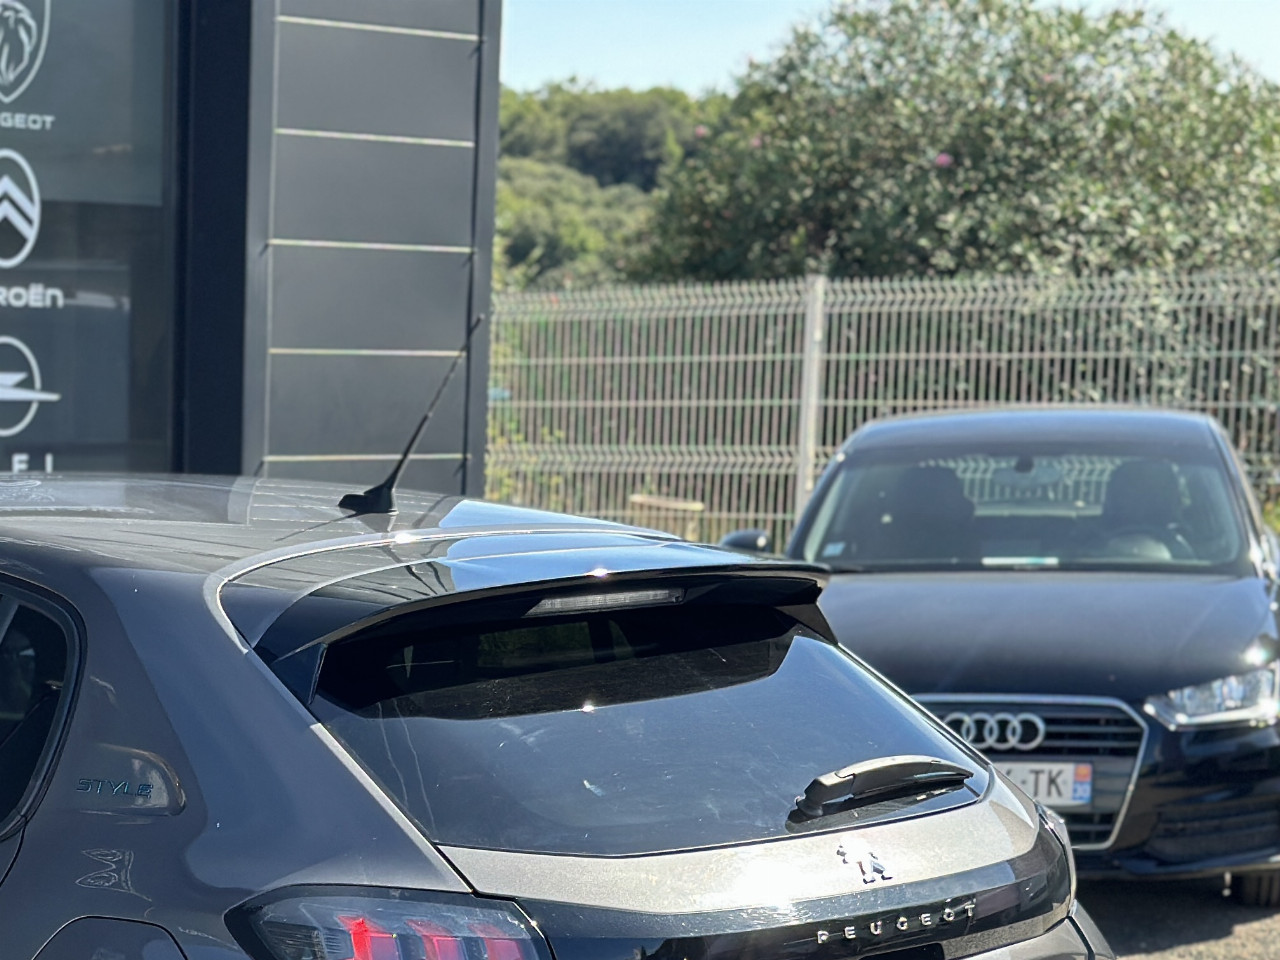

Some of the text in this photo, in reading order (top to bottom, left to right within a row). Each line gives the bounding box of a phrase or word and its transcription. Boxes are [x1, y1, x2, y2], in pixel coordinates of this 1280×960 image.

[76, 778, 154, 798] STYLE
[1006, 767, 1064, 799] -TK
[817, 904, 975, 944] PEUGEOT
